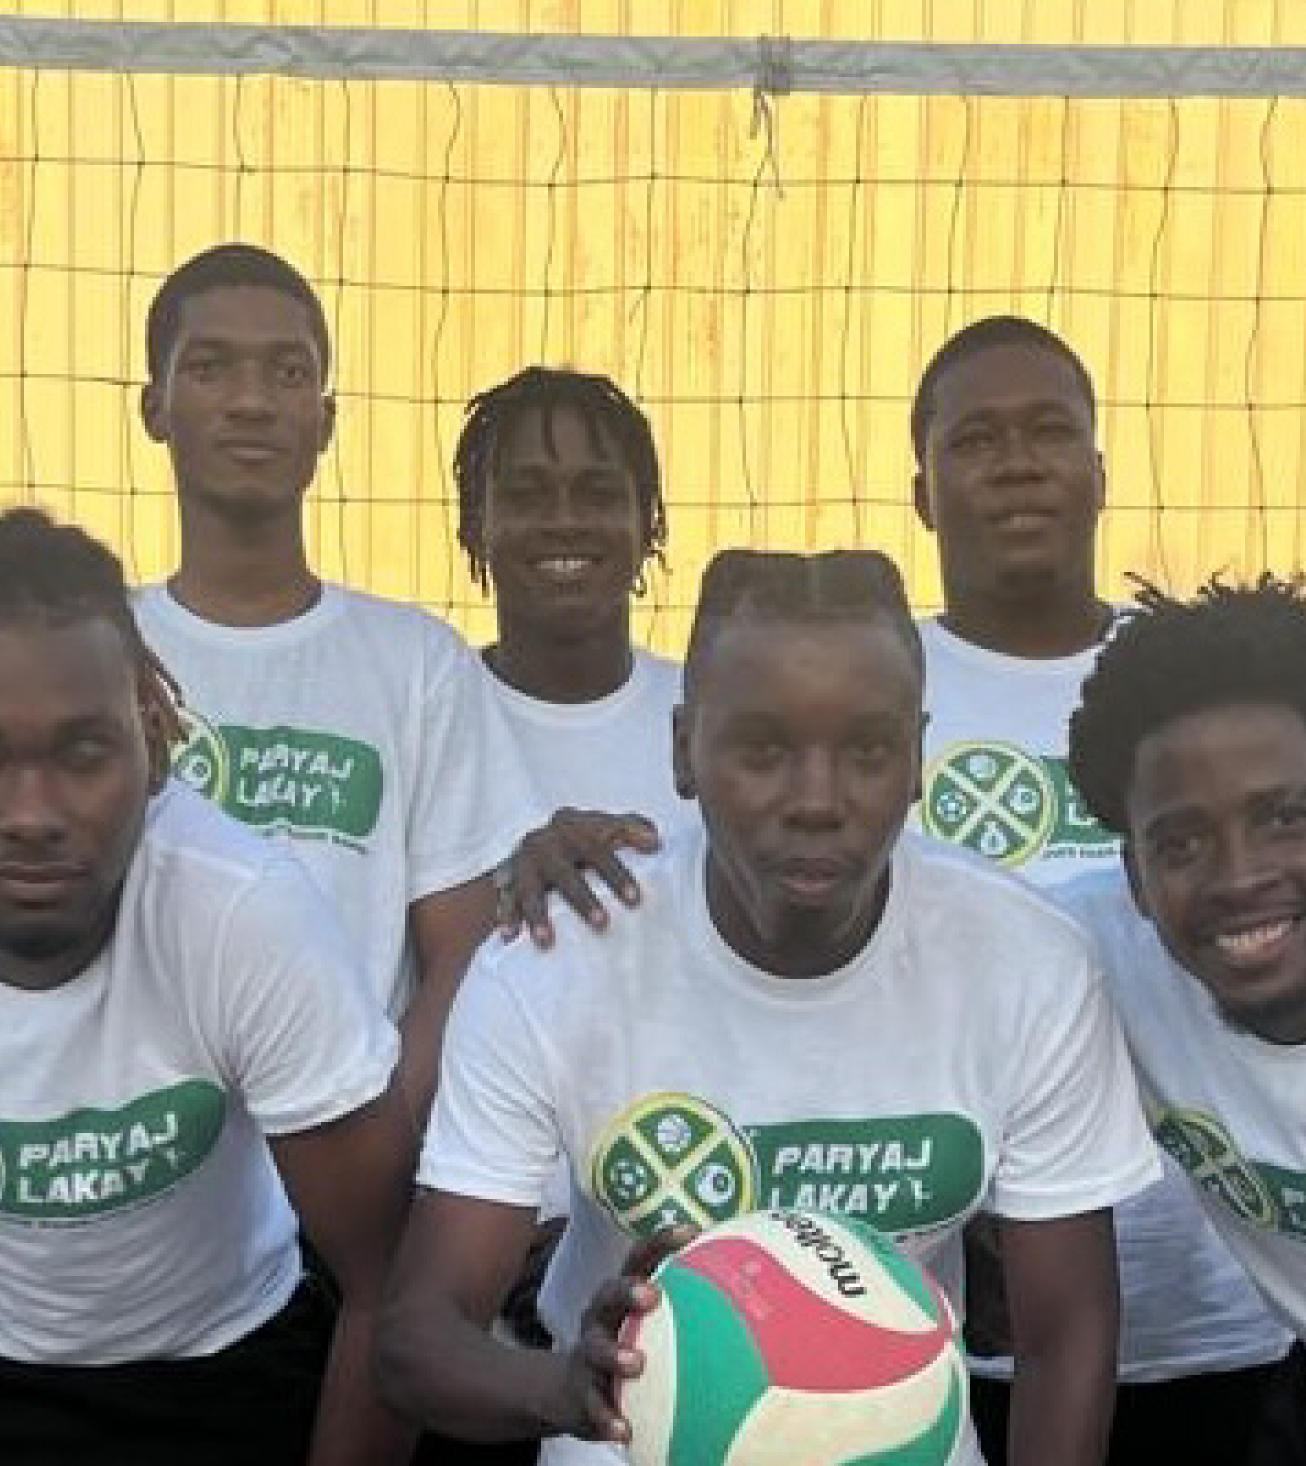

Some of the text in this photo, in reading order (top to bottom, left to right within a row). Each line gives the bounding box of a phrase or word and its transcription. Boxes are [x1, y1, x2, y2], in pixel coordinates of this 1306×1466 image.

[19, 1112, 178, 1170] PARYAJ
[773, 1139, 933, 1175] PARYAJ
[17, 1159, 150, 1204] LAKAY
[772, 1184, 897, 1214] LAKAY
